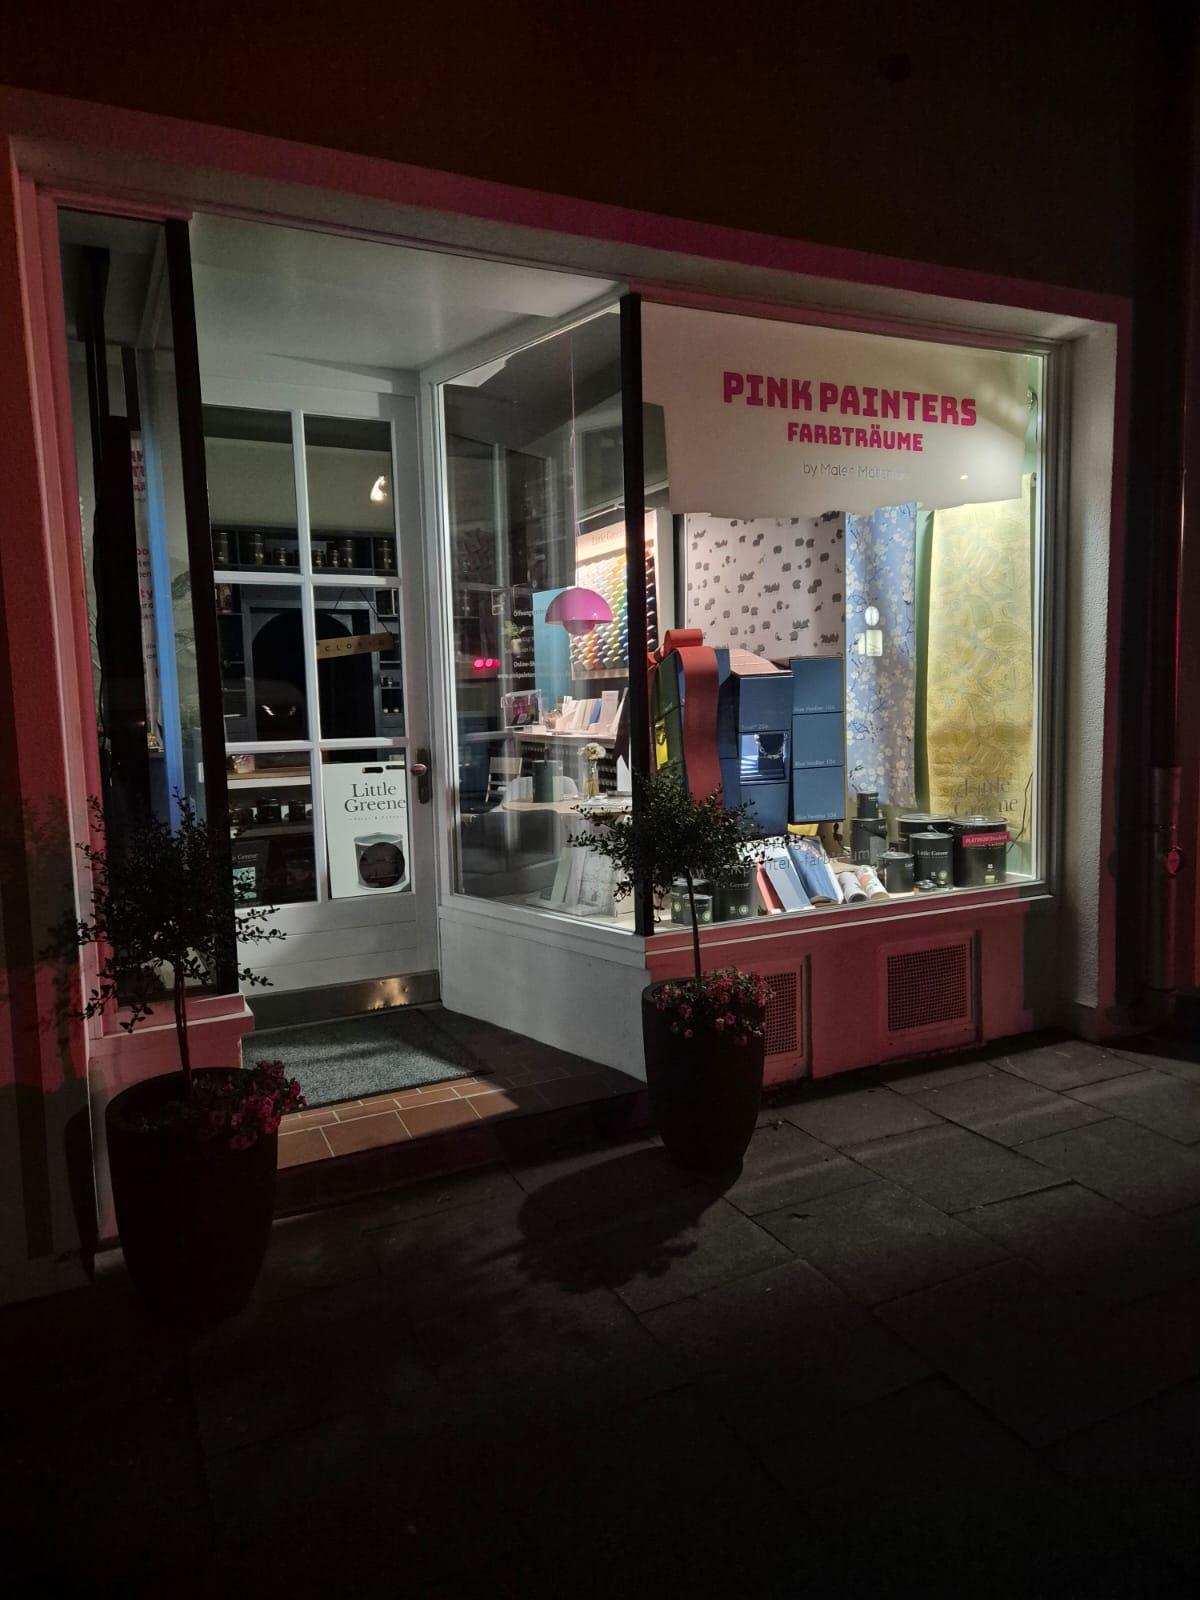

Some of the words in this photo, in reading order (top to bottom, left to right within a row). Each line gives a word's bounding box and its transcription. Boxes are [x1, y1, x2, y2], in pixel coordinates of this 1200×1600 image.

[723, 371, 812, 411] PINK
[819, 382, 977, 427] PAINTERS
[787, 421, 923, 452] FARBTRÄUME
[803, 463, 818, 478] by
[352, 781, 397, 798] Little
[344, 799, 406, 813] Greene
